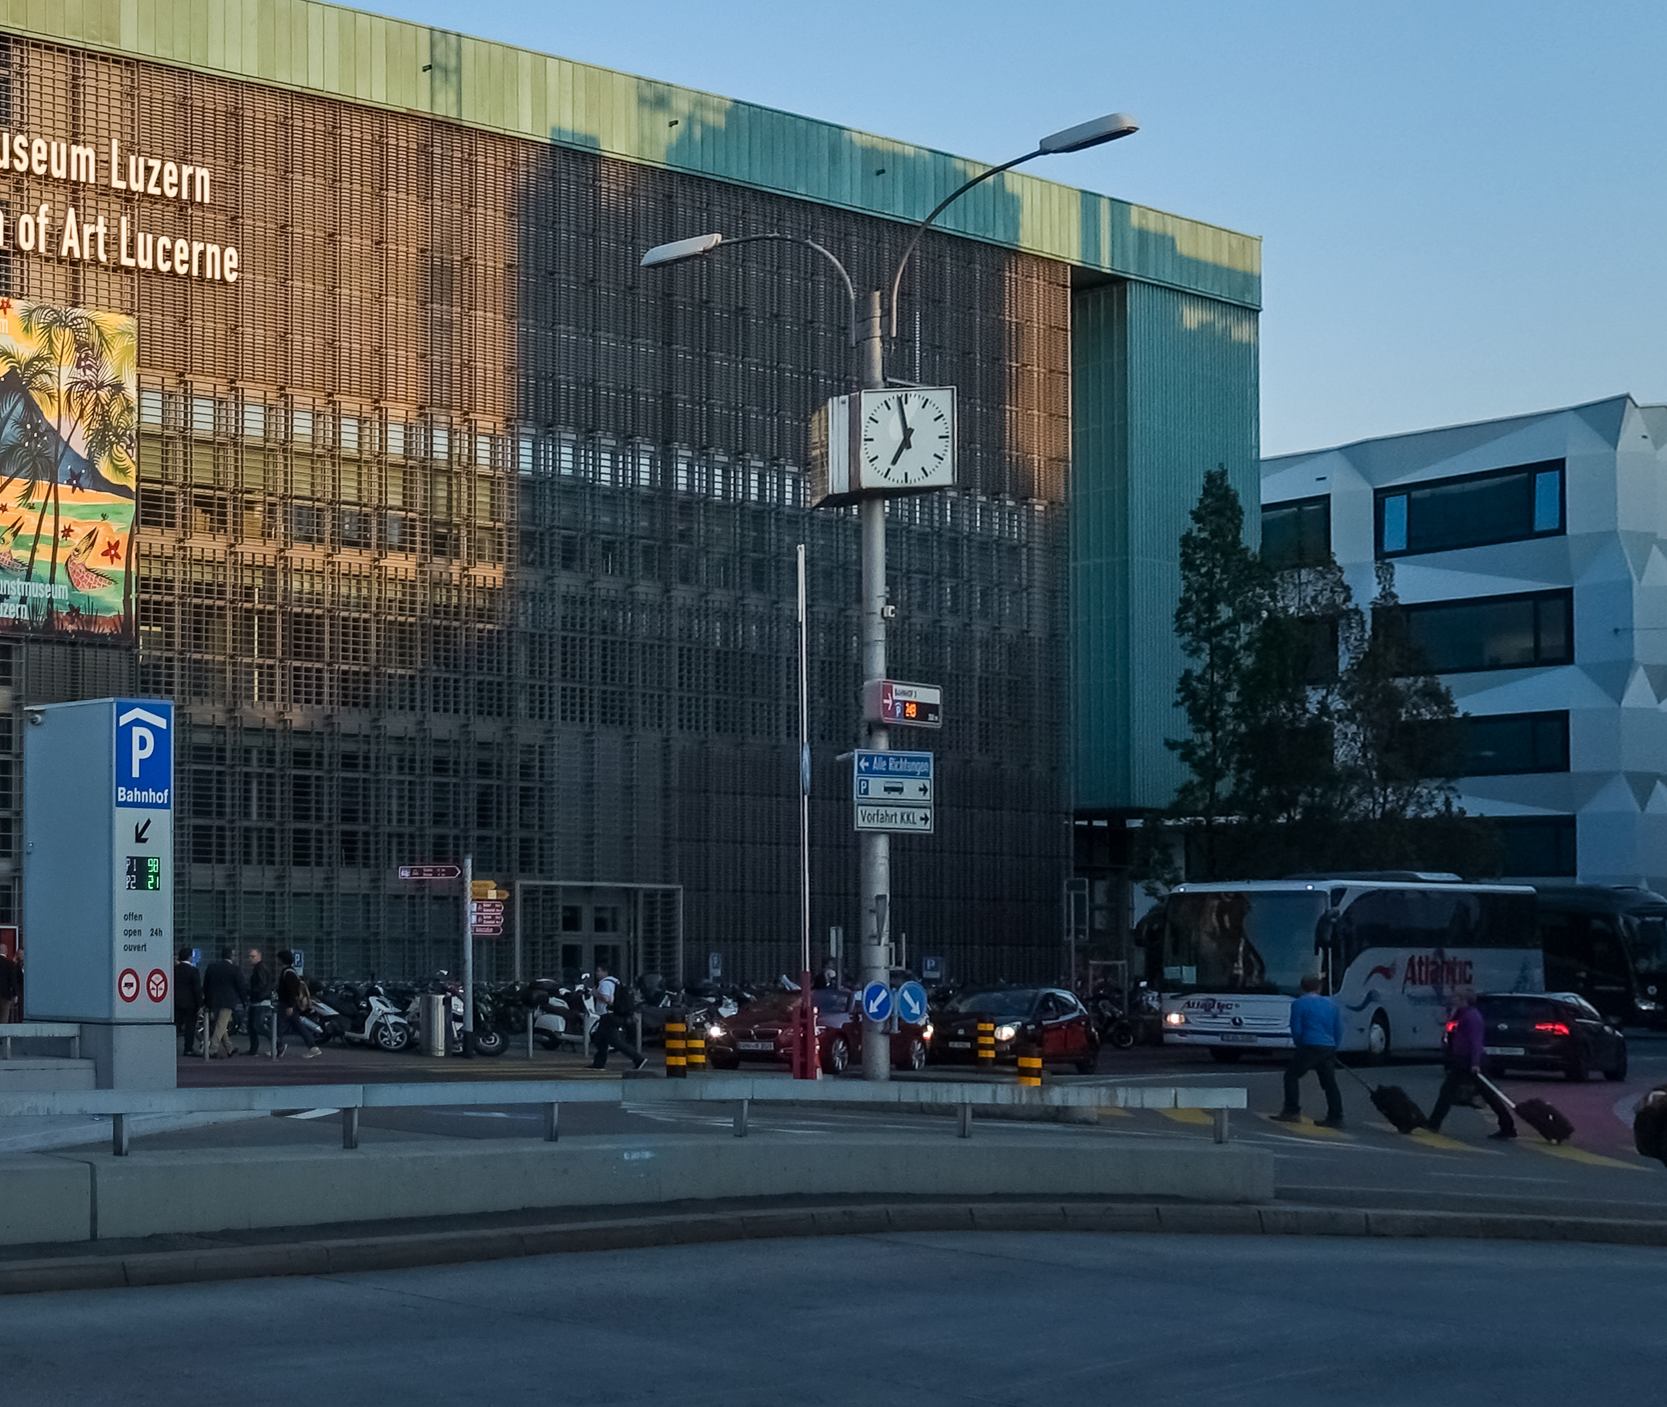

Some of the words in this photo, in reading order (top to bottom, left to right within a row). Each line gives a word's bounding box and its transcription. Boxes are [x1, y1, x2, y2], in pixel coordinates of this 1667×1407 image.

[111, 138, 210, 204] Luzern
[18, 203, 49, 254] of
[60, 207, 108, 263] Art
[120, 216, 239, 283] Lucerne
[132, 726, 155, 778] P
[872, 756, 887, 771] Alle
[888, 757, 929, 776] Richtungen
[117, 786, 169, 804] Bahnhof
[860, 780, 867, 794] P
[860, 809, 898, 824] Vorfahrt
[899, 812, 917, 825] KKL
[147, 858, 159, 873] 98
[147, 874, 160, 890] 21
[123, 912, 143, 922] offen
[123, 928, 142, 938] open
[149, 927, 163, 937] 24h
[123, 943, 147, 952] ouvert
